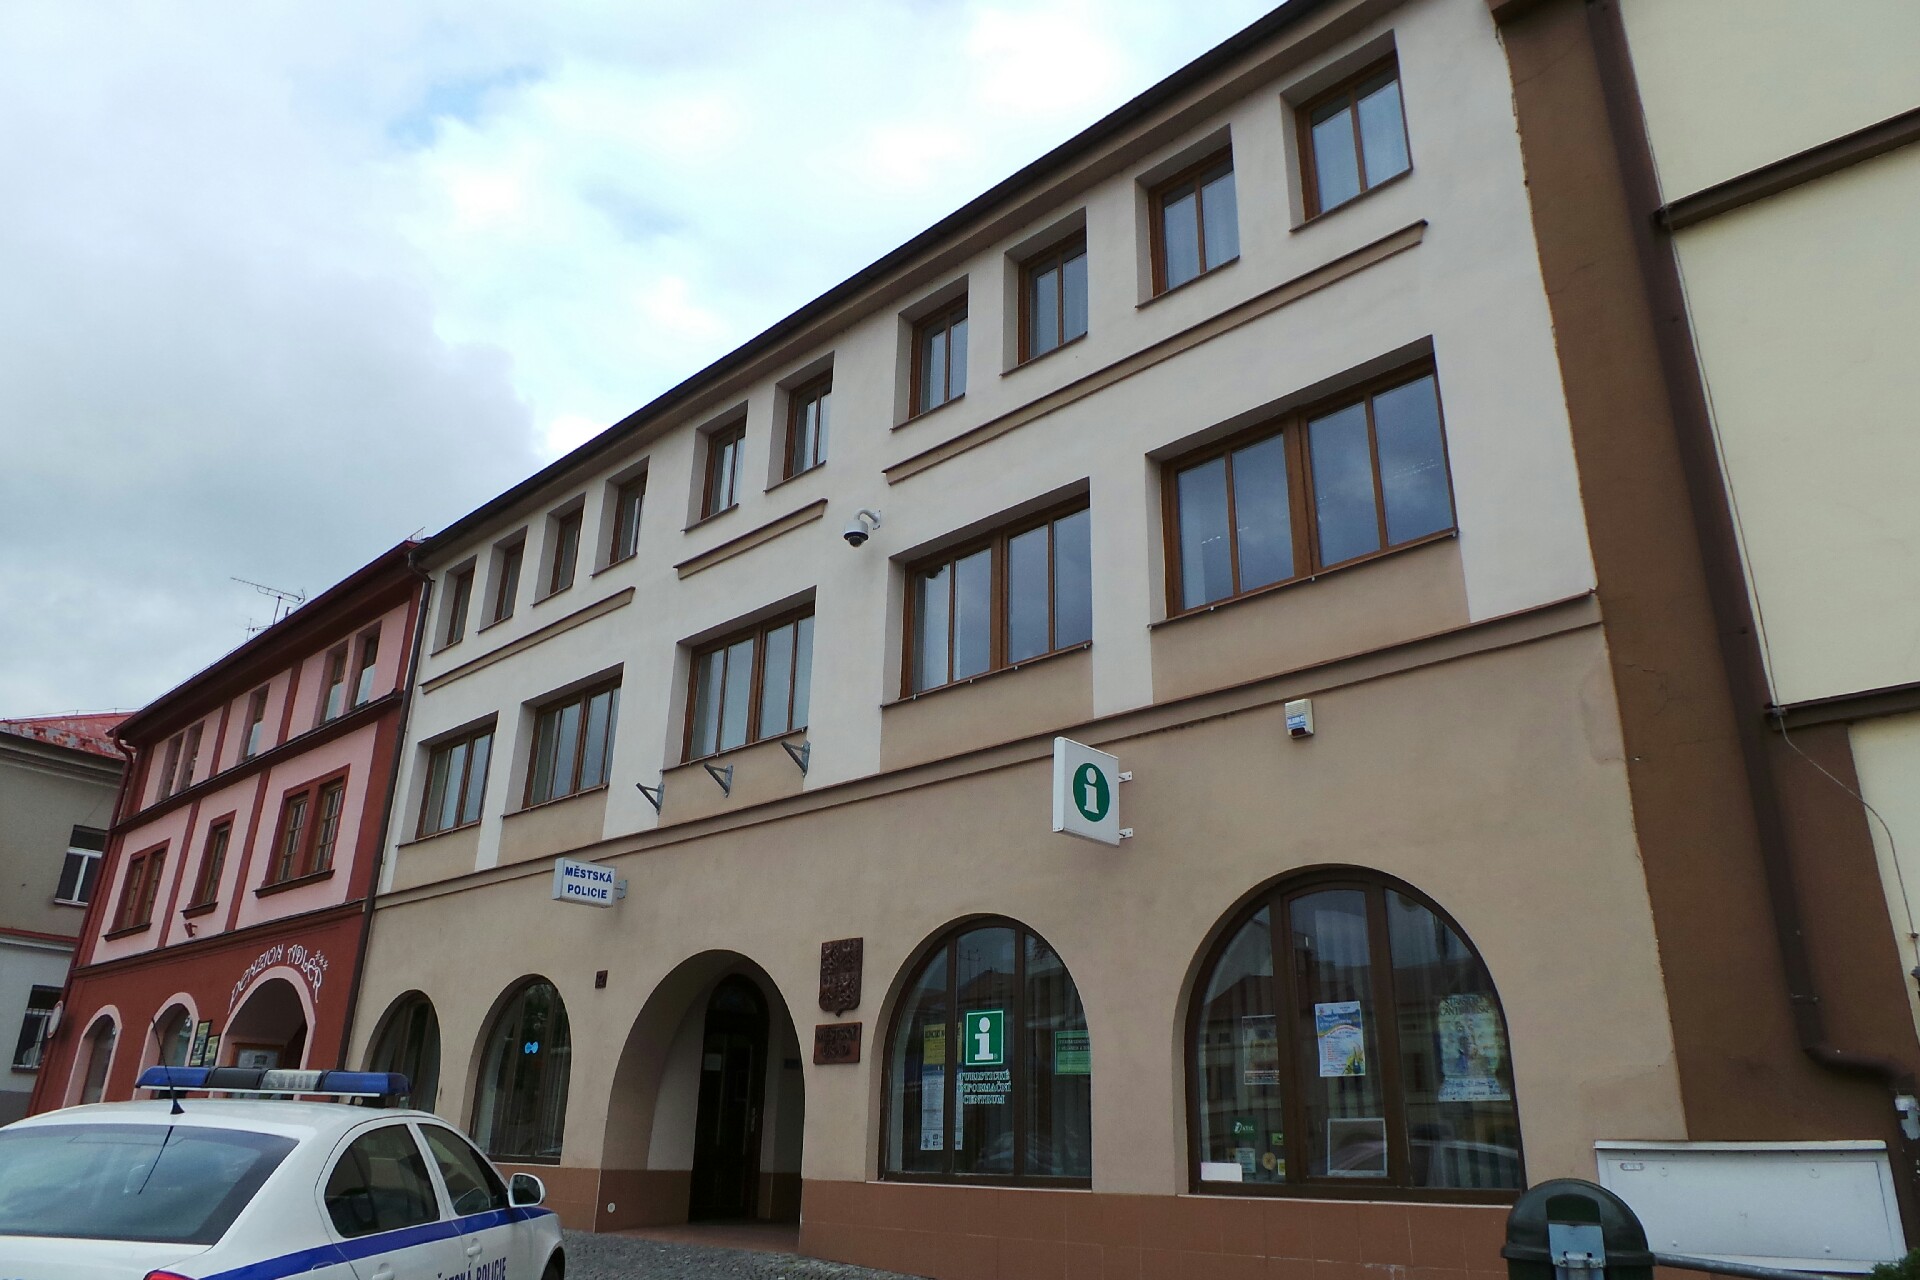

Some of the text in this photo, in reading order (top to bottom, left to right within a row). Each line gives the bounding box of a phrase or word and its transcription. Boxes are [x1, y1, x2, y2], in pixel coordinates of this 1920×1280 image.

[565, 865, 612, 883] MĚSTSKÁ
[567, 884, 608, 899] POLICIE
[228, 944, 322, 1014] PENZION ADLER
[959, 1068, 1010, 1081] TURISTICKÉ
[959, 1080, 1012, 1092] INFORMAČNÍ
[963, 1094, 1006, 1105] CENTRUM
[476, 1257, 507, 1280] POLICIE
